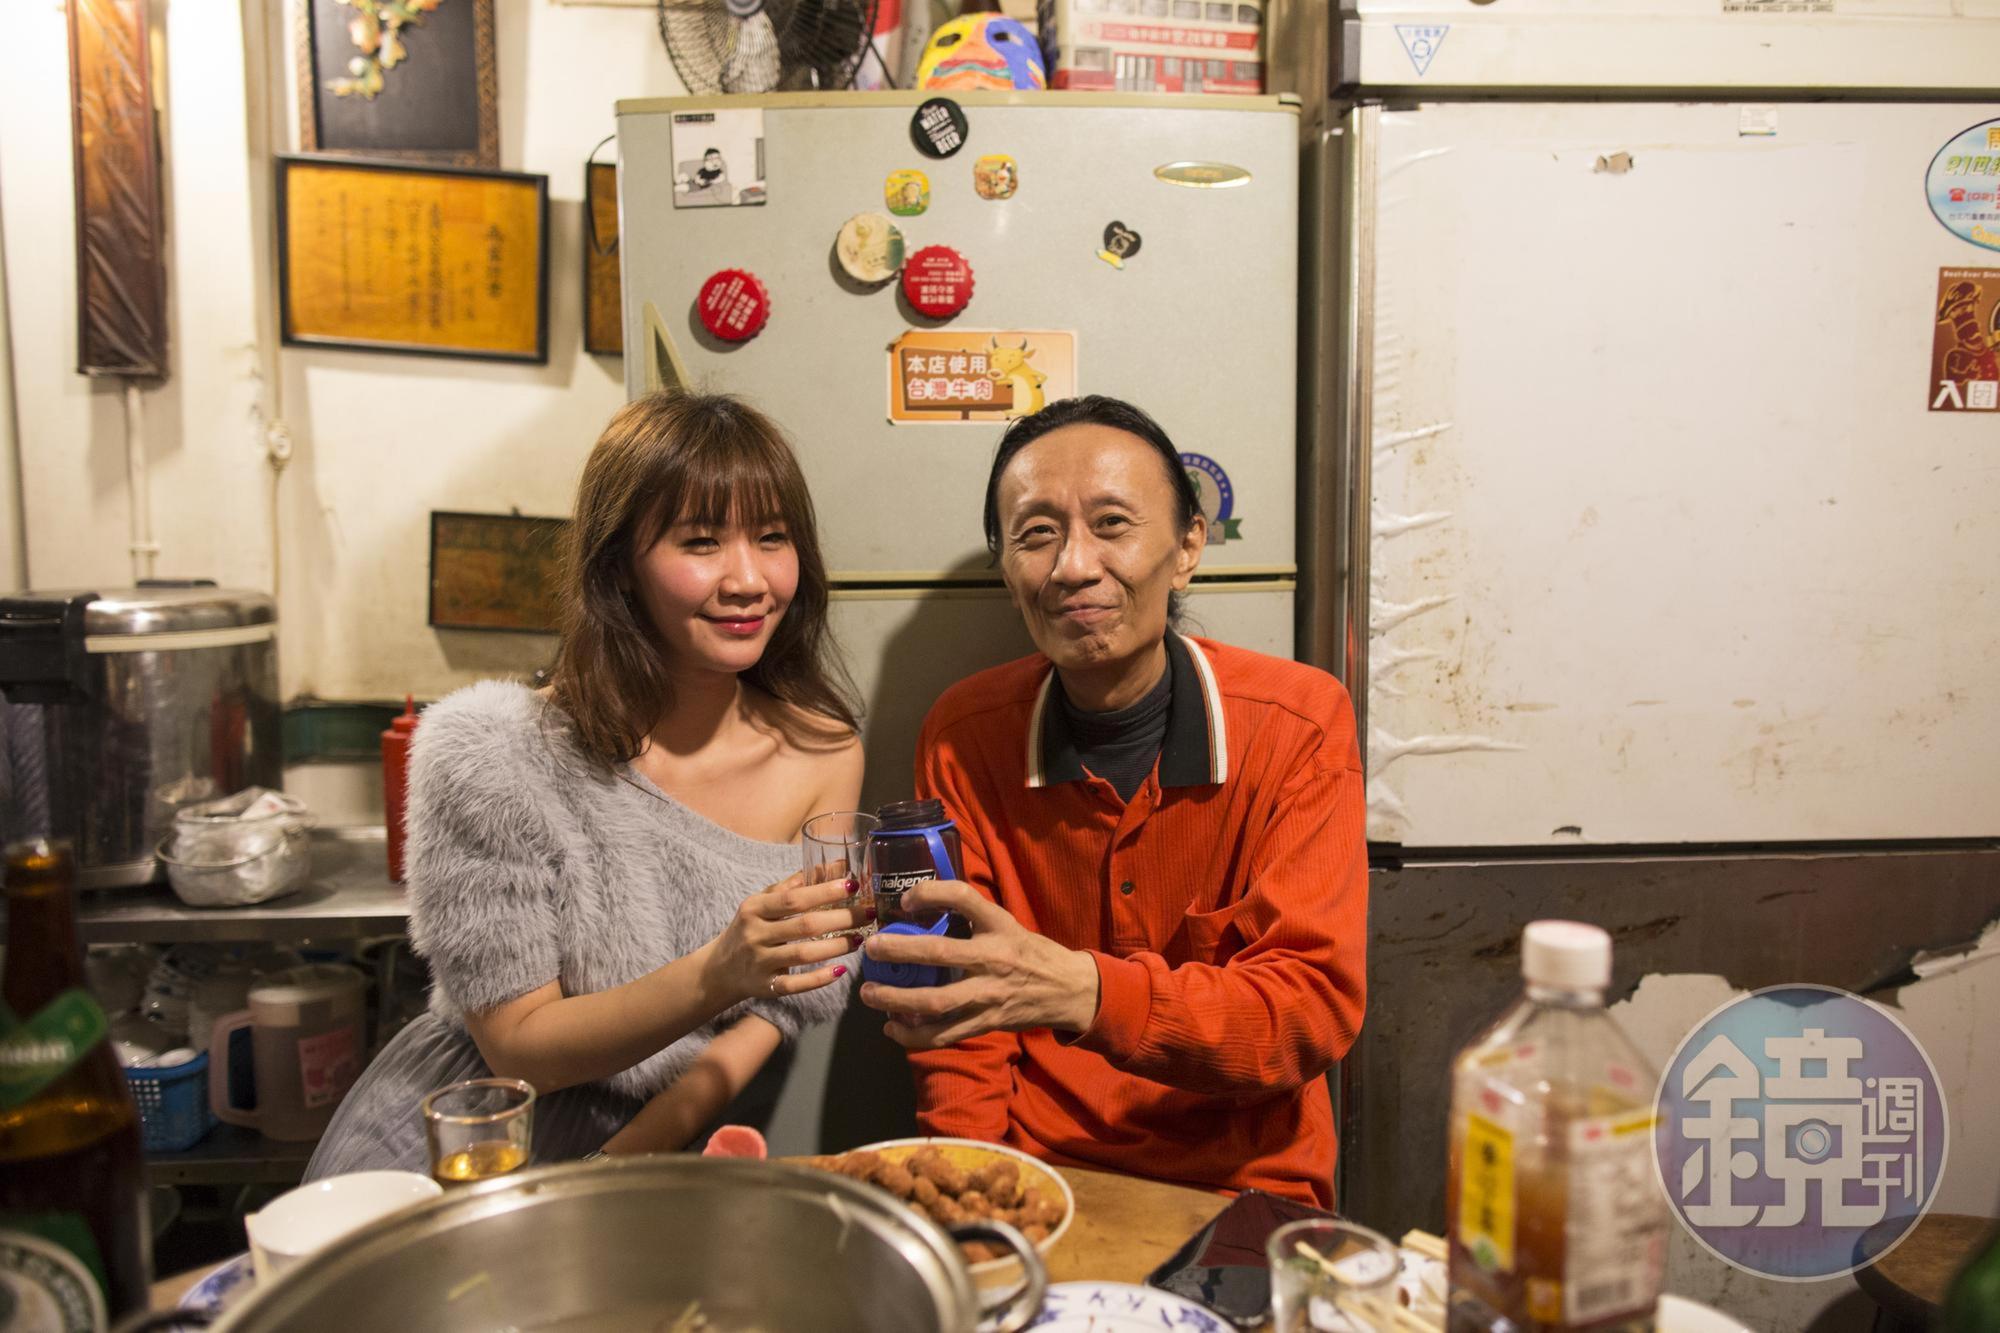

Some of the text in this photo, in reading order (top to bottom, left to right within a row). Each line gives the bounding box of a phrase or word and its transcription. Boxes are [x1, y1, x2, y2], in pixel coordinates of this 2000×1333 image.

[935, 132, 961, 154] BEER
[907, 355, 988, 375] 本店使用
[907, 378, 994, 400] 台灣牛肉
